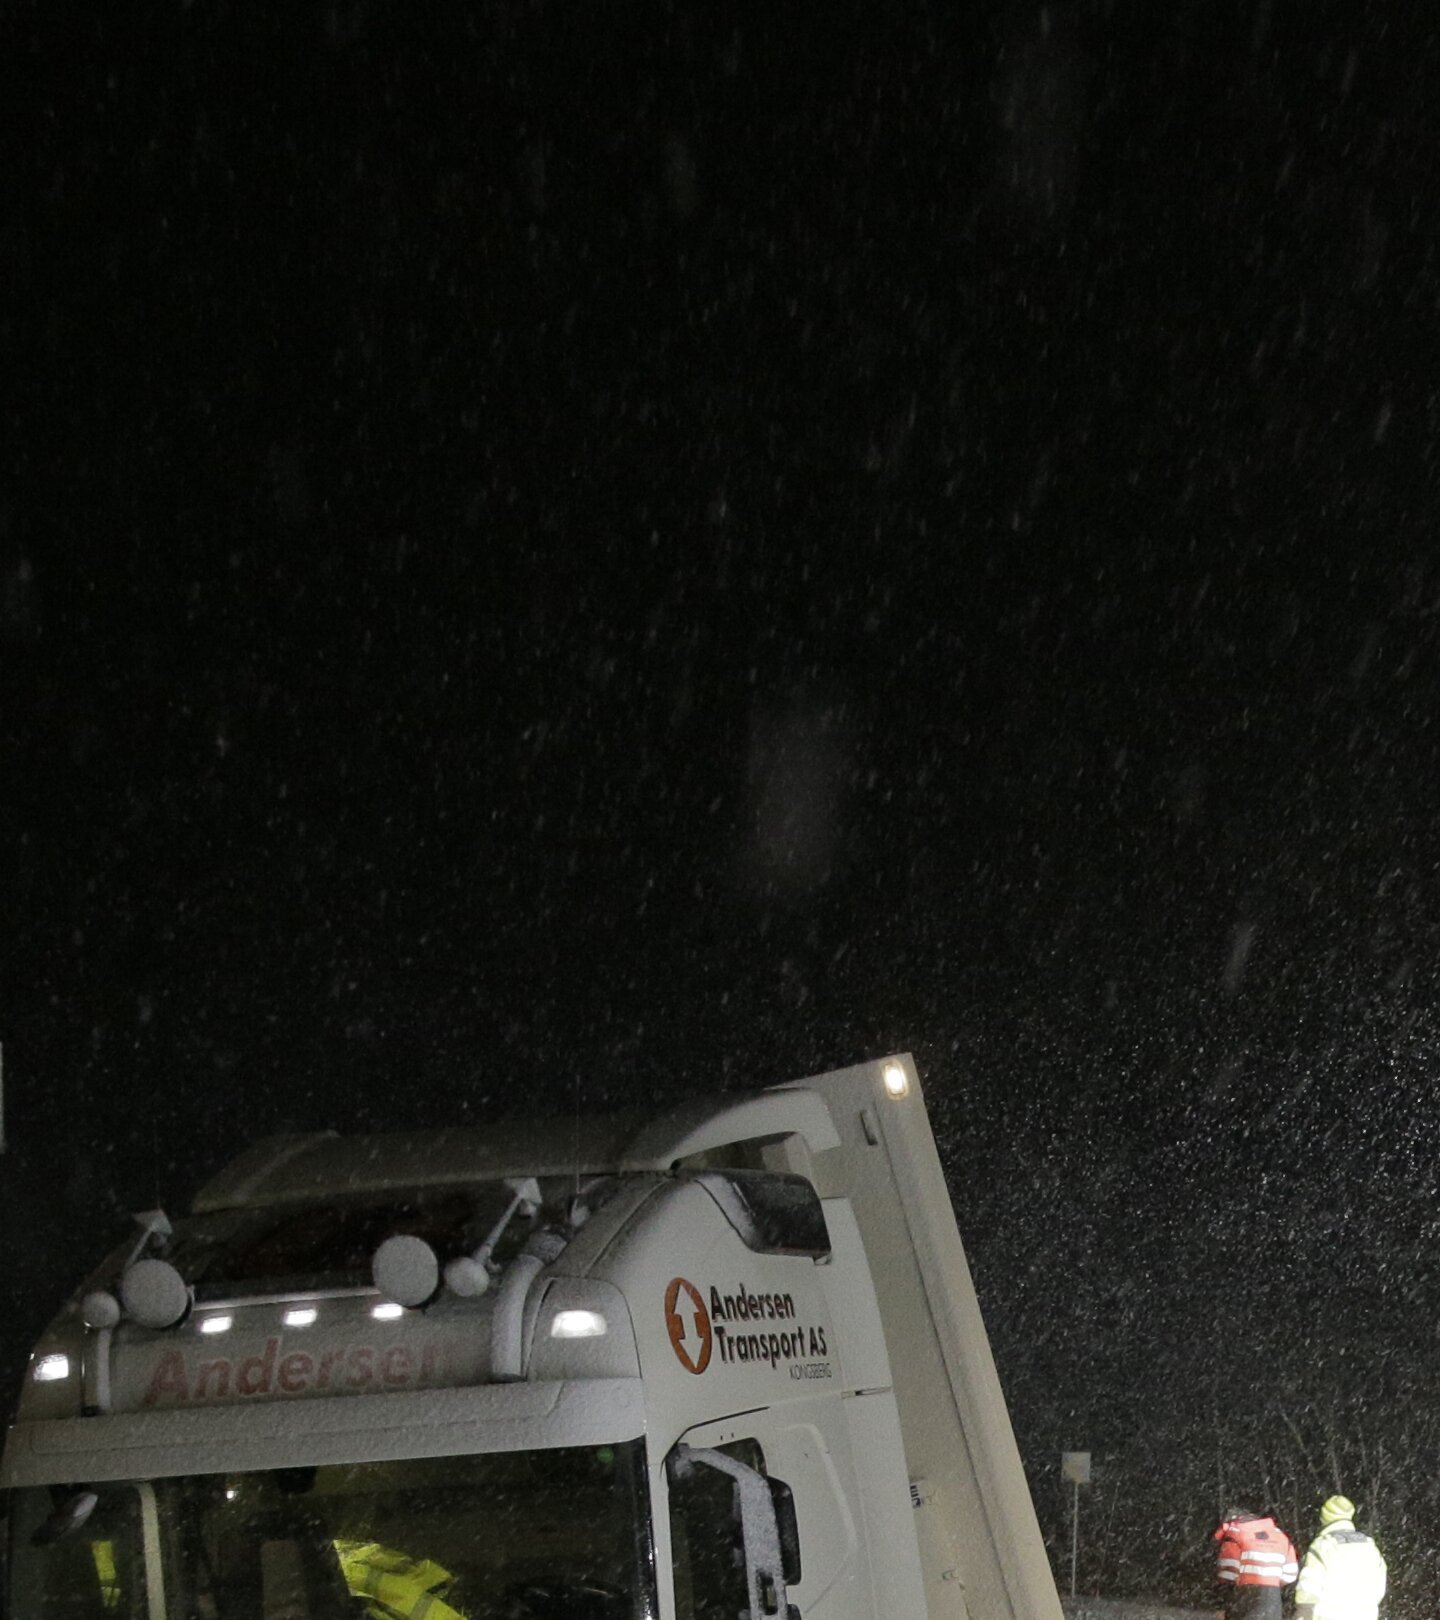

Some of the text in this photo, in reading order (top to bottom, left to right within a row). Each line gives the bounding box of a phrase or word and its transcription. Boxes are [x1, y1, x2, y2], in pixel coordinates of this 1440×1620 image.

[710, 1282, 795, 1322] Andersen
[714, 1326, 827, 1369] Transport AS
